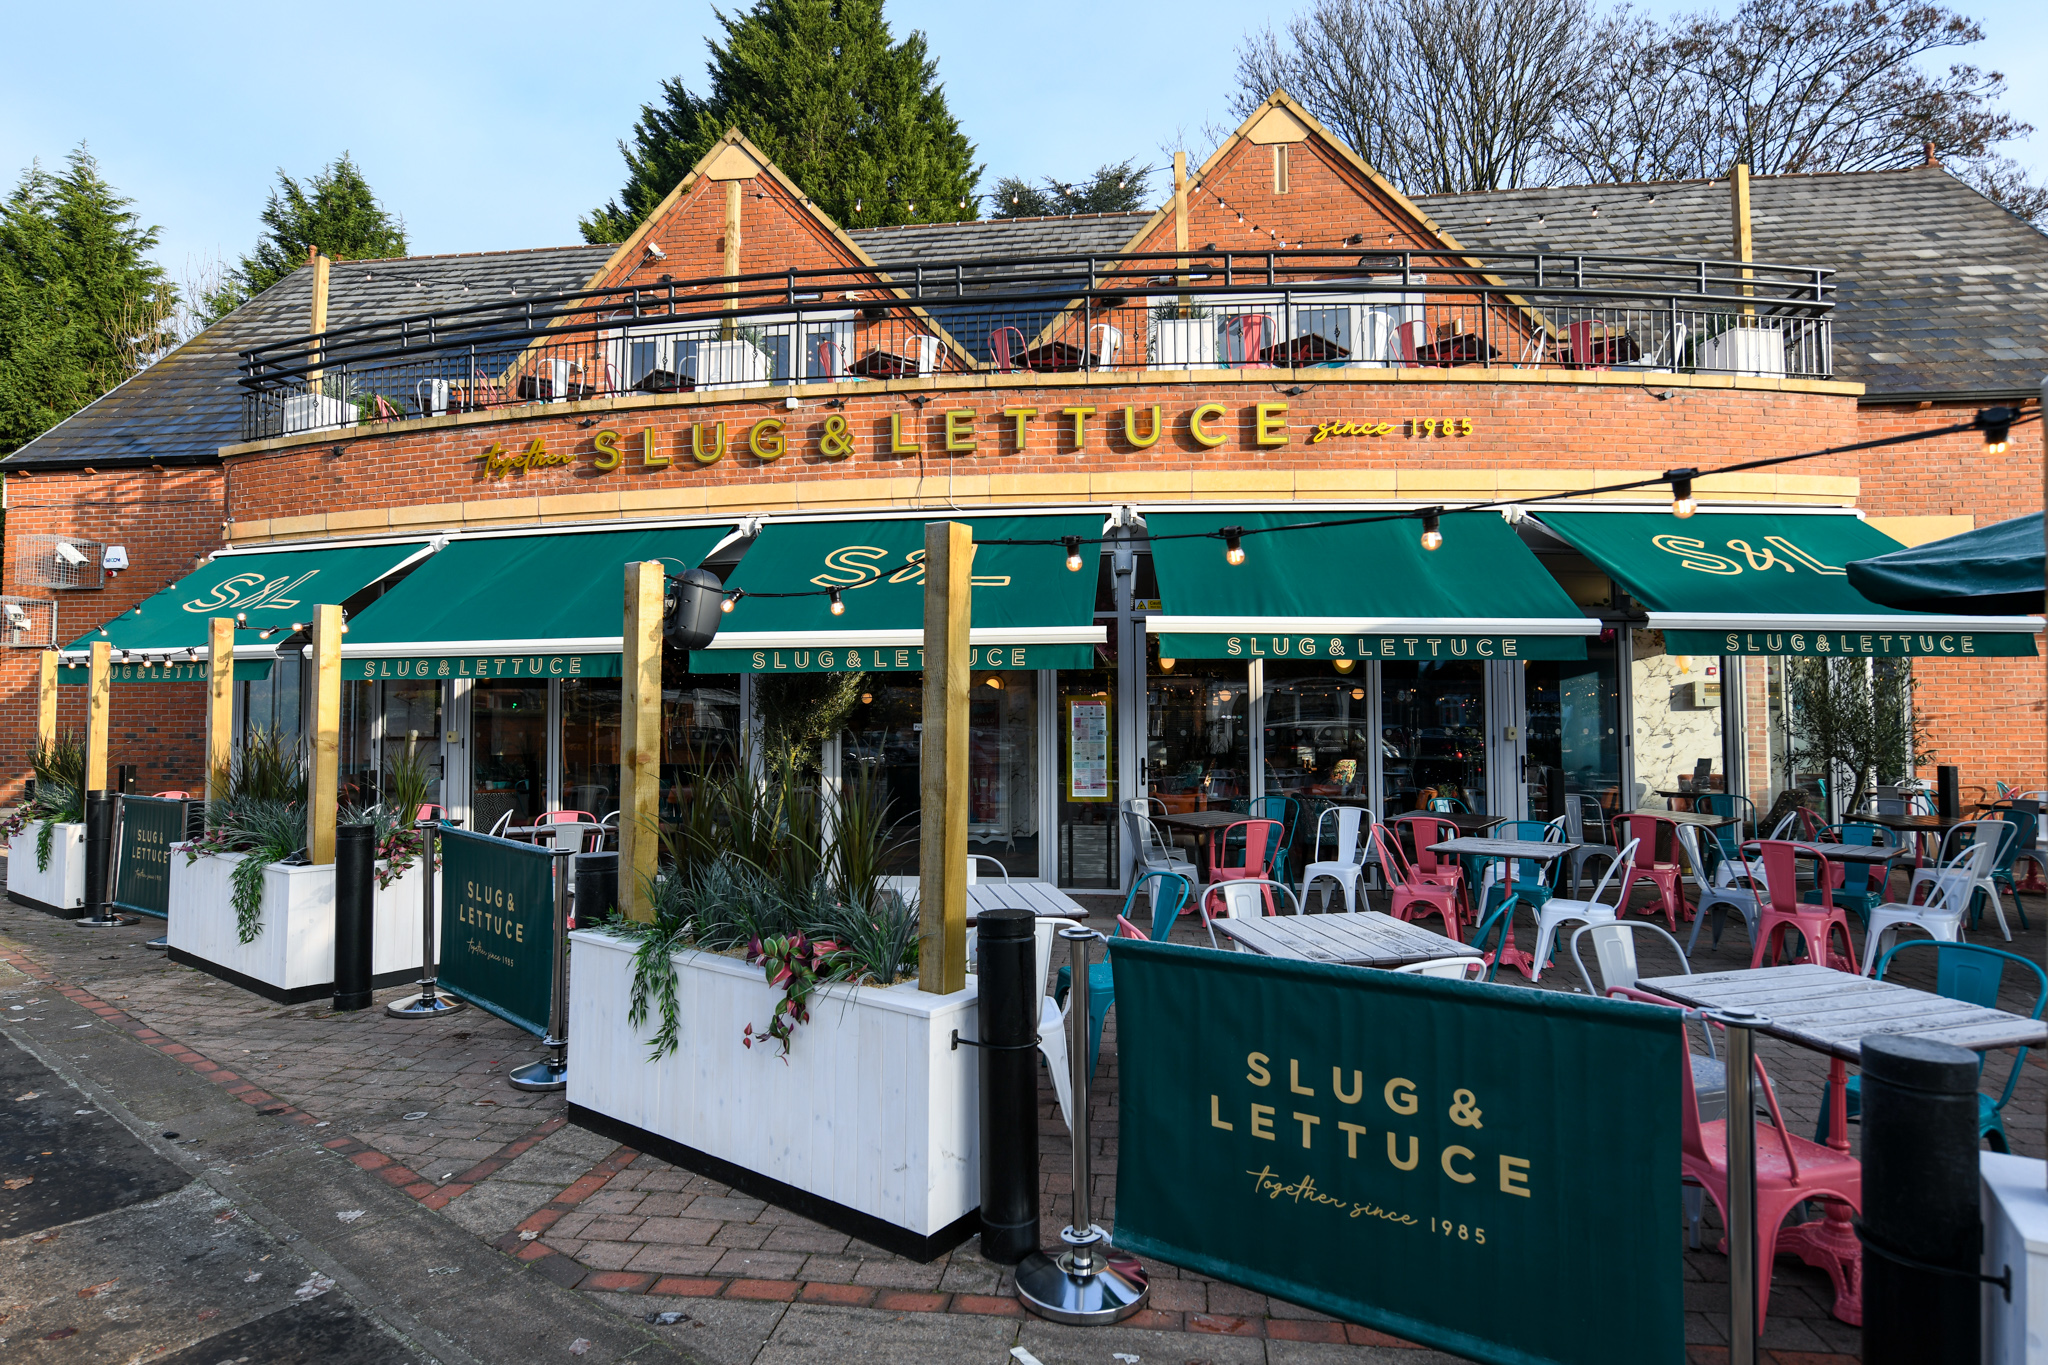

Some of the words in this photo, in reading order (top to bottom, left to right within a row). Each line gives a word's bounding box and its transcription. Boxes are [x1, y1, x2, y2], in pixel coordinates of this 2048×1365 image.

[475, 436, 577, 478] together
[593, 416, 787, 471] SLUG
[819, 413, 855, 458] &
[890, 402, 1290, 454] LETTUCE
[1312, 419, 1396, 444] since
[1411, 416, 1473, 438] 1985
[1227, 637, 1316, 656] SLUG
[1328, 637, 1345, 656] &
[1358, 638, 1518, 657] LETTUCE
[1725, 633, 1805, 652] SLUG
[1815, 633, 1831, 653] &
[1841, 634, 1975, 653] LETTUCE
[364, 660, 429, 677] SLUG
[437, 659, 450, 676] &
[459, 657, 582, 676] LETTUCE
[752, 650, 835, 669] SLUG
[846, 650, 861, 668] &
[110, 665, 132, 680] UG
[136, 664, 146, 680] &
[150, 663, 208, 679] LETTU
[137, 829, 157, 844] SLUG
[132, 846, 168, 864] LETTUCE
[467, 880, 503, 908] SLUG
[507, 892, 515, 912] &
[459, 903, 524, 943] LETTUCE
[1246, 1051, 1419, 1116] SLUG
[1448, 1088, 1484, 1130] &
[1211, 1094, 1531, 1198] LETTUCE
[1246, 1164, 1347, 1209] together
[1349, 1201, 1418, 1226] since
[1431, 1216, 1487, 1245] 1985
